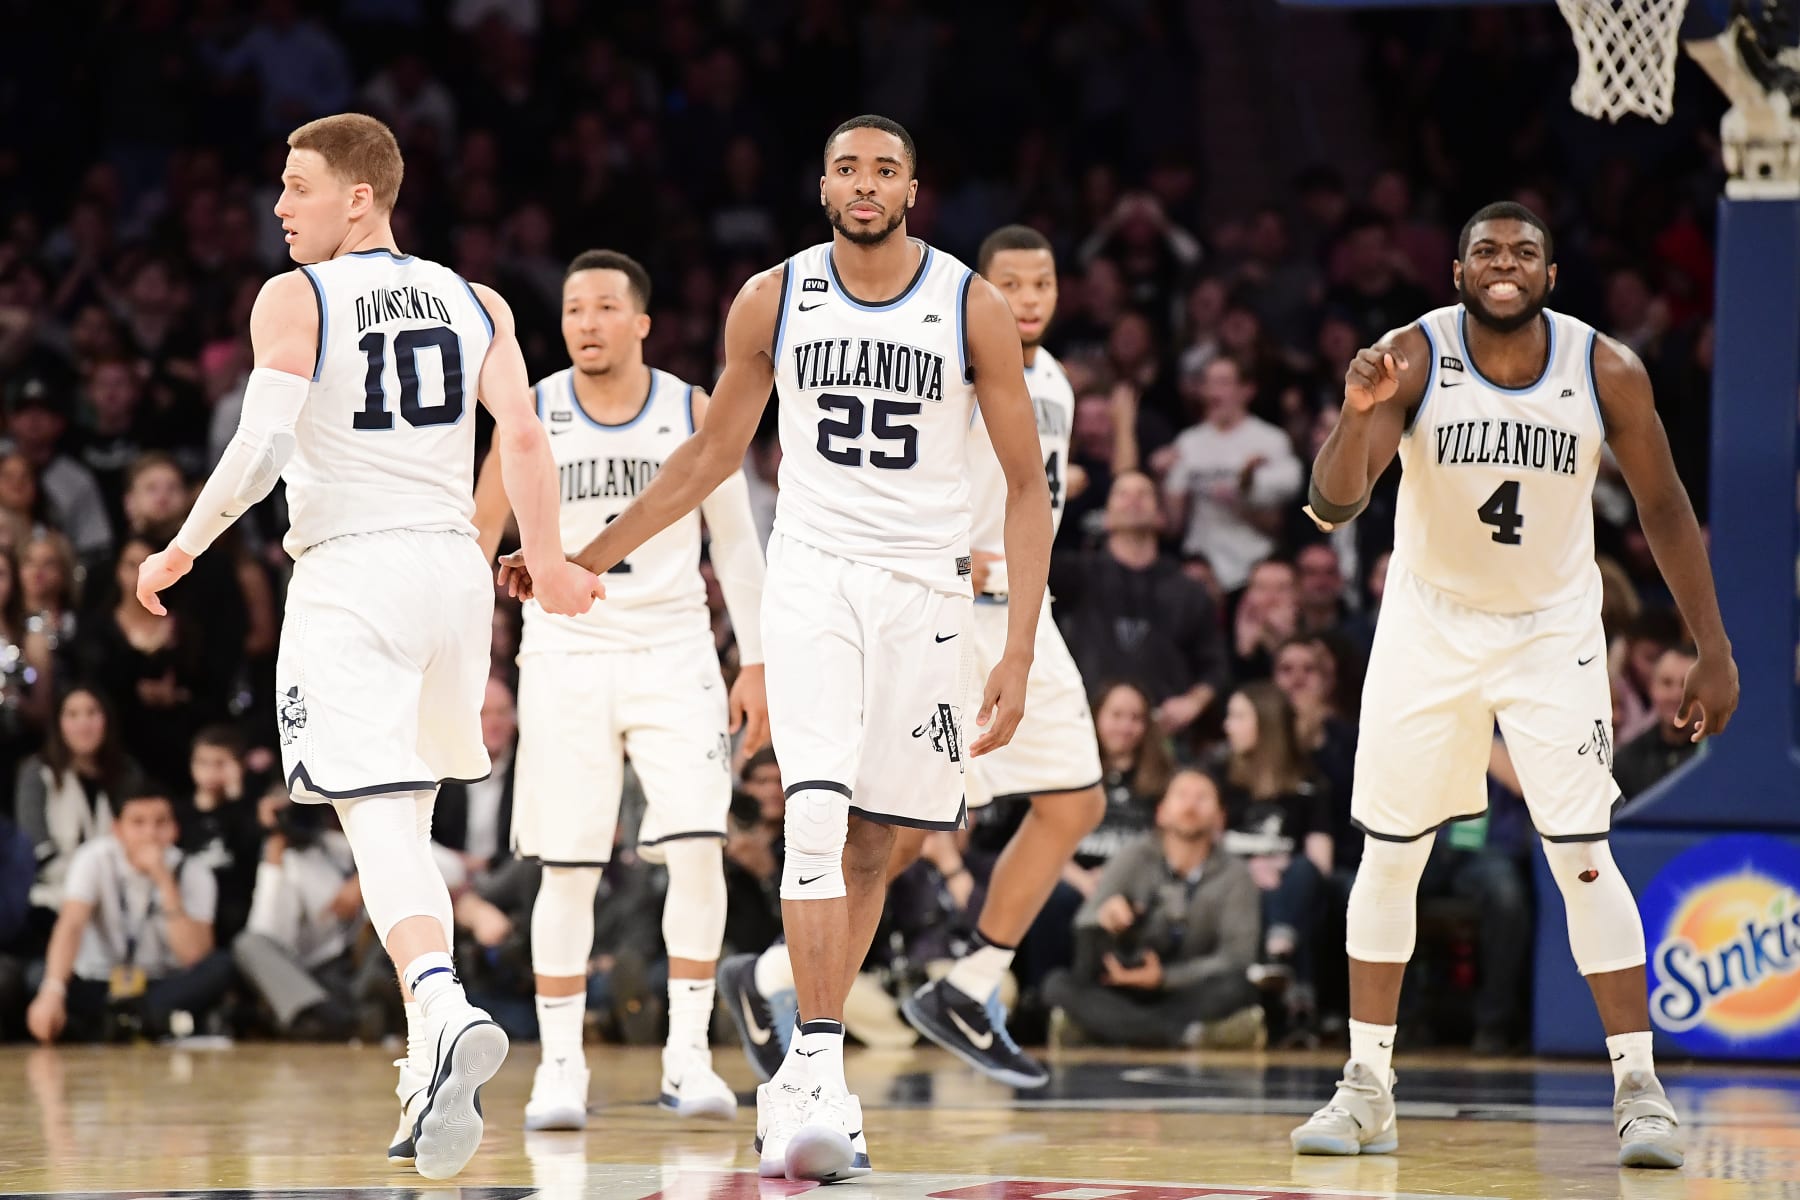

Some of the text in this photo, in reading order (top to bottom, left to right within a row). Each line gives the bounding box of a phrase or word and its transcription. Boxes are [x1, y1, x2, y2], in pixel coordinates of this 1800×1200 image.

[805, 280, 825, 290] RVM
[352, 326, 465, 431] 10
[793, 338, 945, 403] VILLANOVA
[816, 392, 922, 470] 25
[1435, 419, 1580, 476] VILLANOVA
[1477, 480, 1523, 545] 4
[942, 708, 958, 758] VILLANOVA
